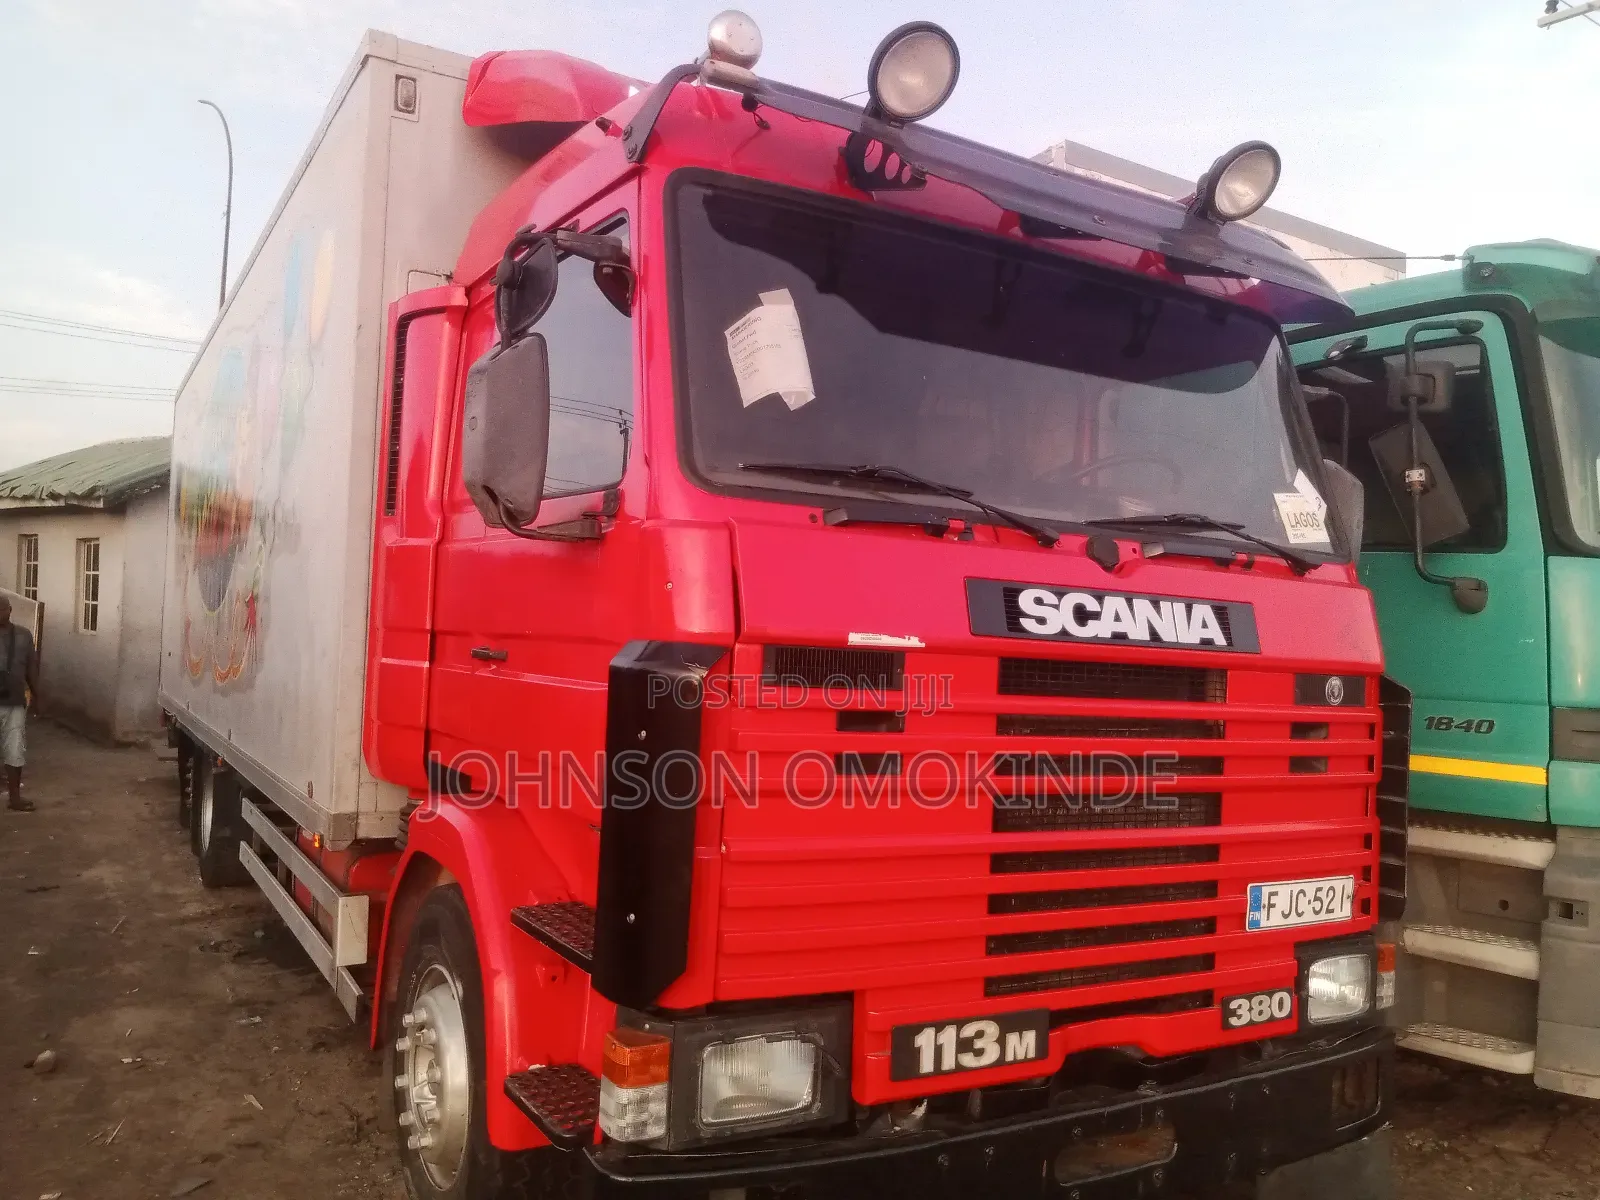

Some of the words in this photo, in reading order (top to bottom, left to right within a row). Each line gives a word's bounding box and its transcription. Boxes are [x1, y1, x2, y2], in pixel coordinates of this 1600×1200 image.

[1286, 511, 1320, 529] LAGOS
[1018, 588, 1228, 646] SCANIA
[1424, 715, 1496, 735] 1840
[1249, 912, 1261, 921] FIN
[1266, 884, 1346, 921] FJC-521
[1228, 991, 1291, 1026] 380
